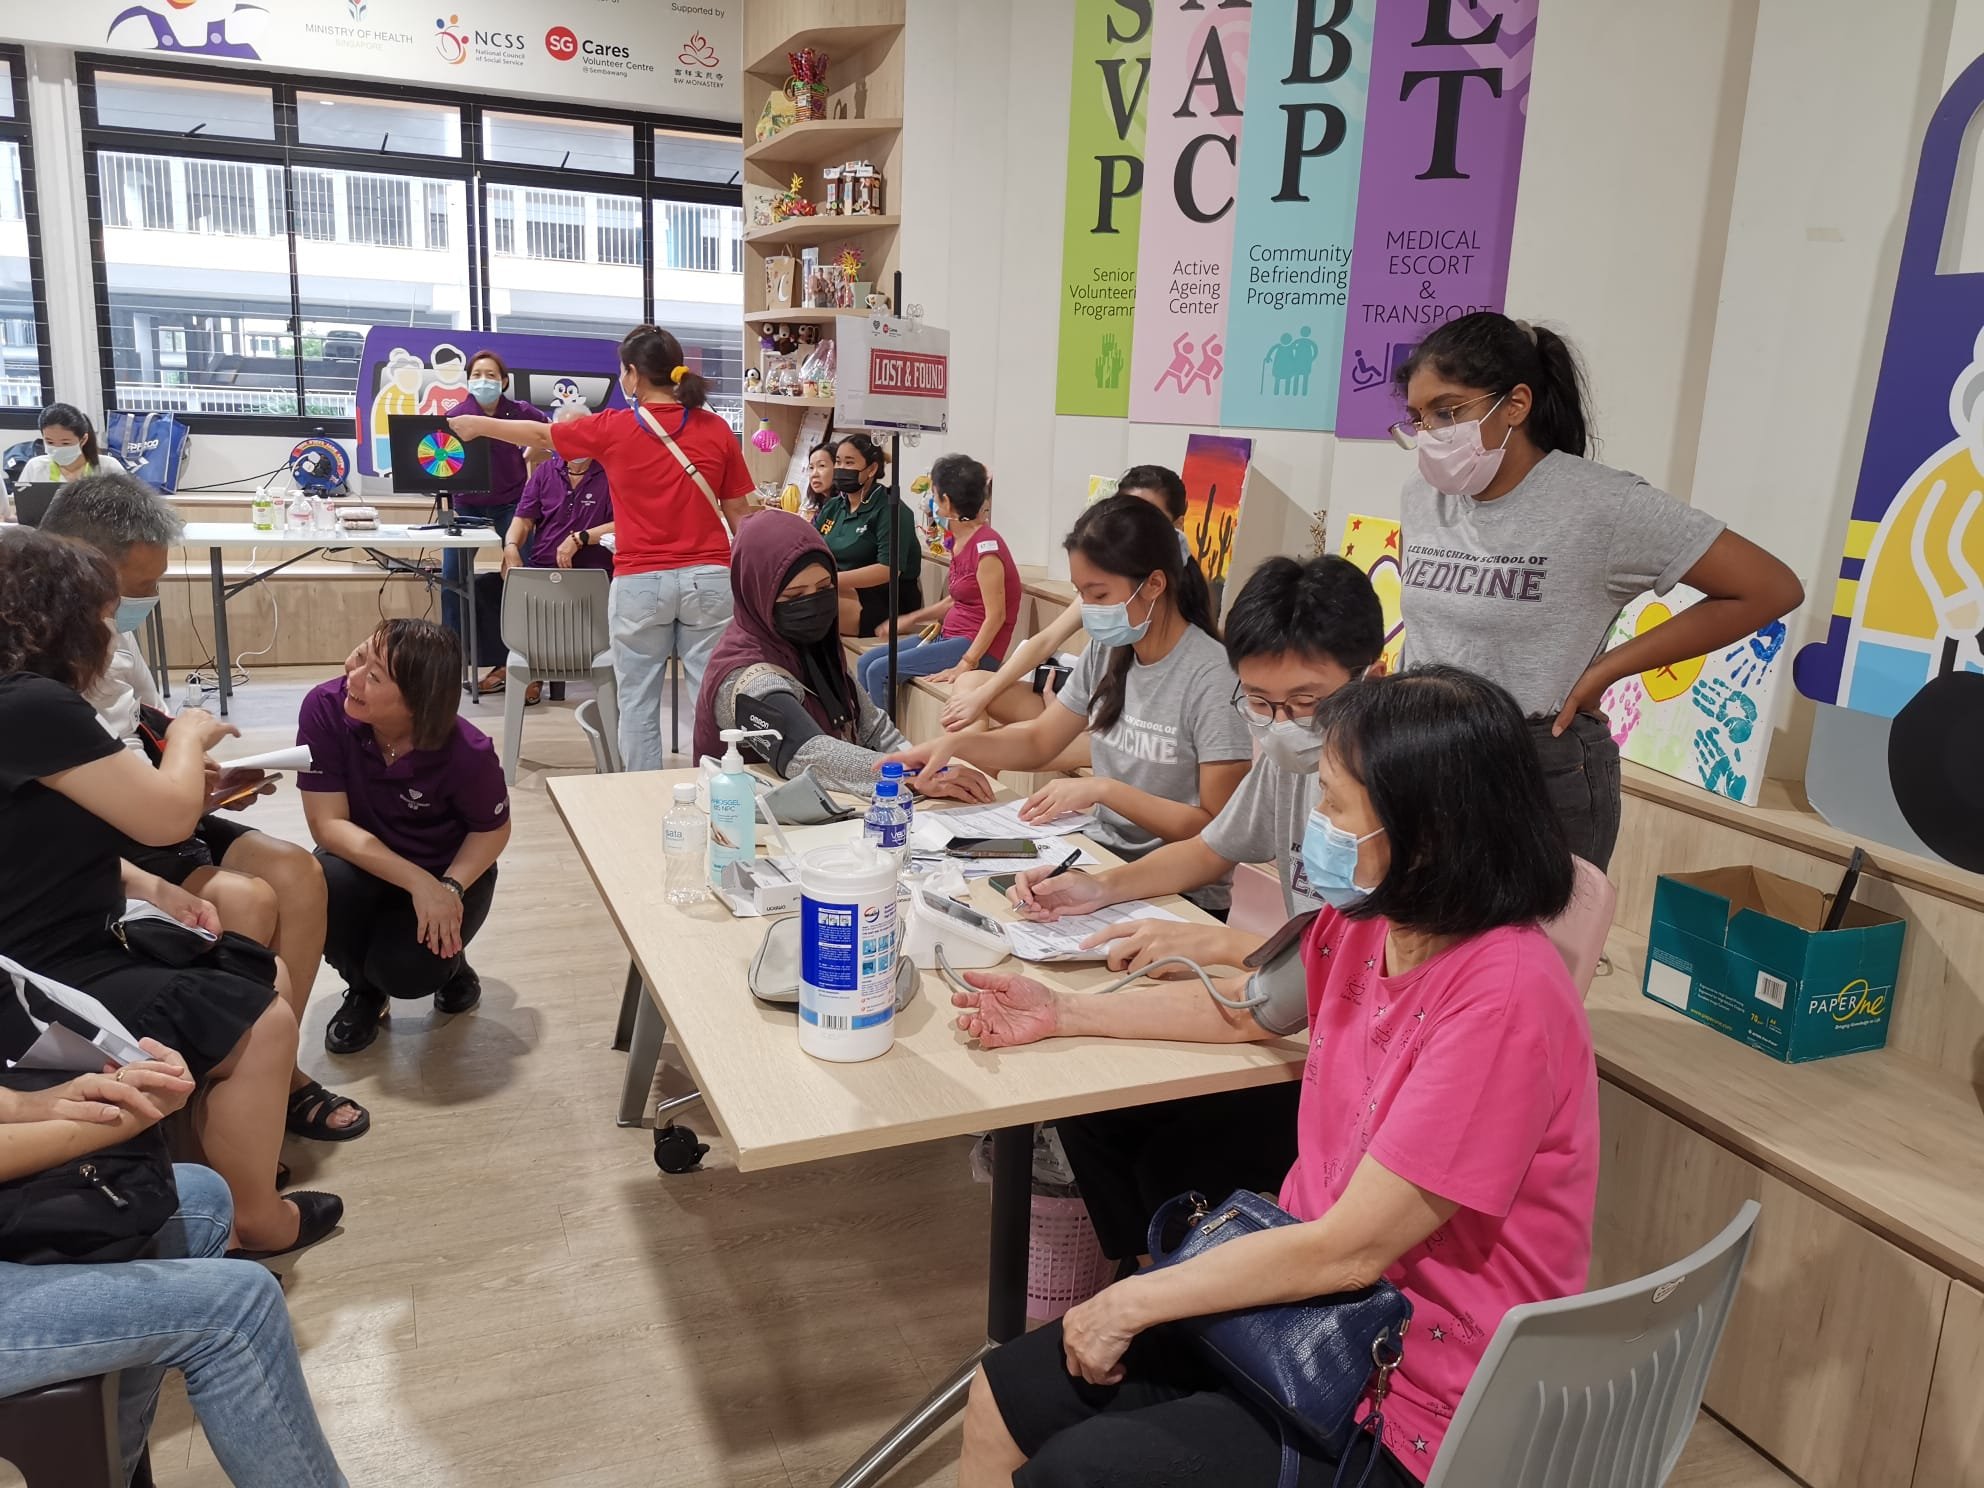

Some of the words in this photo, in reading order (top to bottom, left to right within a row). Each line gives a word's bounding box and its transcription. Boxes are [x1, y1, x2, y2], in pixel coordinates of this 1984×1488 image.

[671, 3, 713, 16] Supported
[715, 8, 725, 18] by
[305, 23, 354, 38] MINISTRY
[357, 30, 372, 39] OF
[374, 31, 413, 44] HEALTH
[475, 31, 525, 50] NCSS
[335, 39, 384, 51] SINGAPORE
[475, 48, 501, 58] National
[502, 50, 526, 60] Council
[550, 35, 574, 52] SG
[582, 40, 630, 58] Cares
[484, 56, 501, 64] Social
[503, 58, 524, 67] Service
[582, 56, 624, 69] Volunteer
[626, 61, 654, 72] Centre
[582, 67, 628, 78] @Sembawang
[686, 80, 724, 88] MONASTERY
[1386, 230, 1481, 250] MEDICAL
[1249, 244, 1352, 267] Community
[1389, 255, 1474, 275] ESCORT
[1093, 267, 1135, 282] Senior
[1173, 260, 1220, 276] Active
[1250, 266, 1348, 289] Befriending
[1169, 279, 1221, 300] Ageing
[1247, 288, 1347, 310] Programme
[1419, 280, 1436, 300] &
[1169, 298, 1219, 314] Center
[875, 358, 904, 387] LOST
[904, 361, 912, 387] &
[913, 362, 944, 389] FOUND
[1408, 544, 1422, 554] LEE
[1422, 547, 1445, 558] KONG
[1480, 555, 1525, 564] SCHOOL
[1528, 556, 1548, 566] OF
[1401, 556, 1548, 602] MEDICINE
[1103, 722, 1178, 765] DICINE
